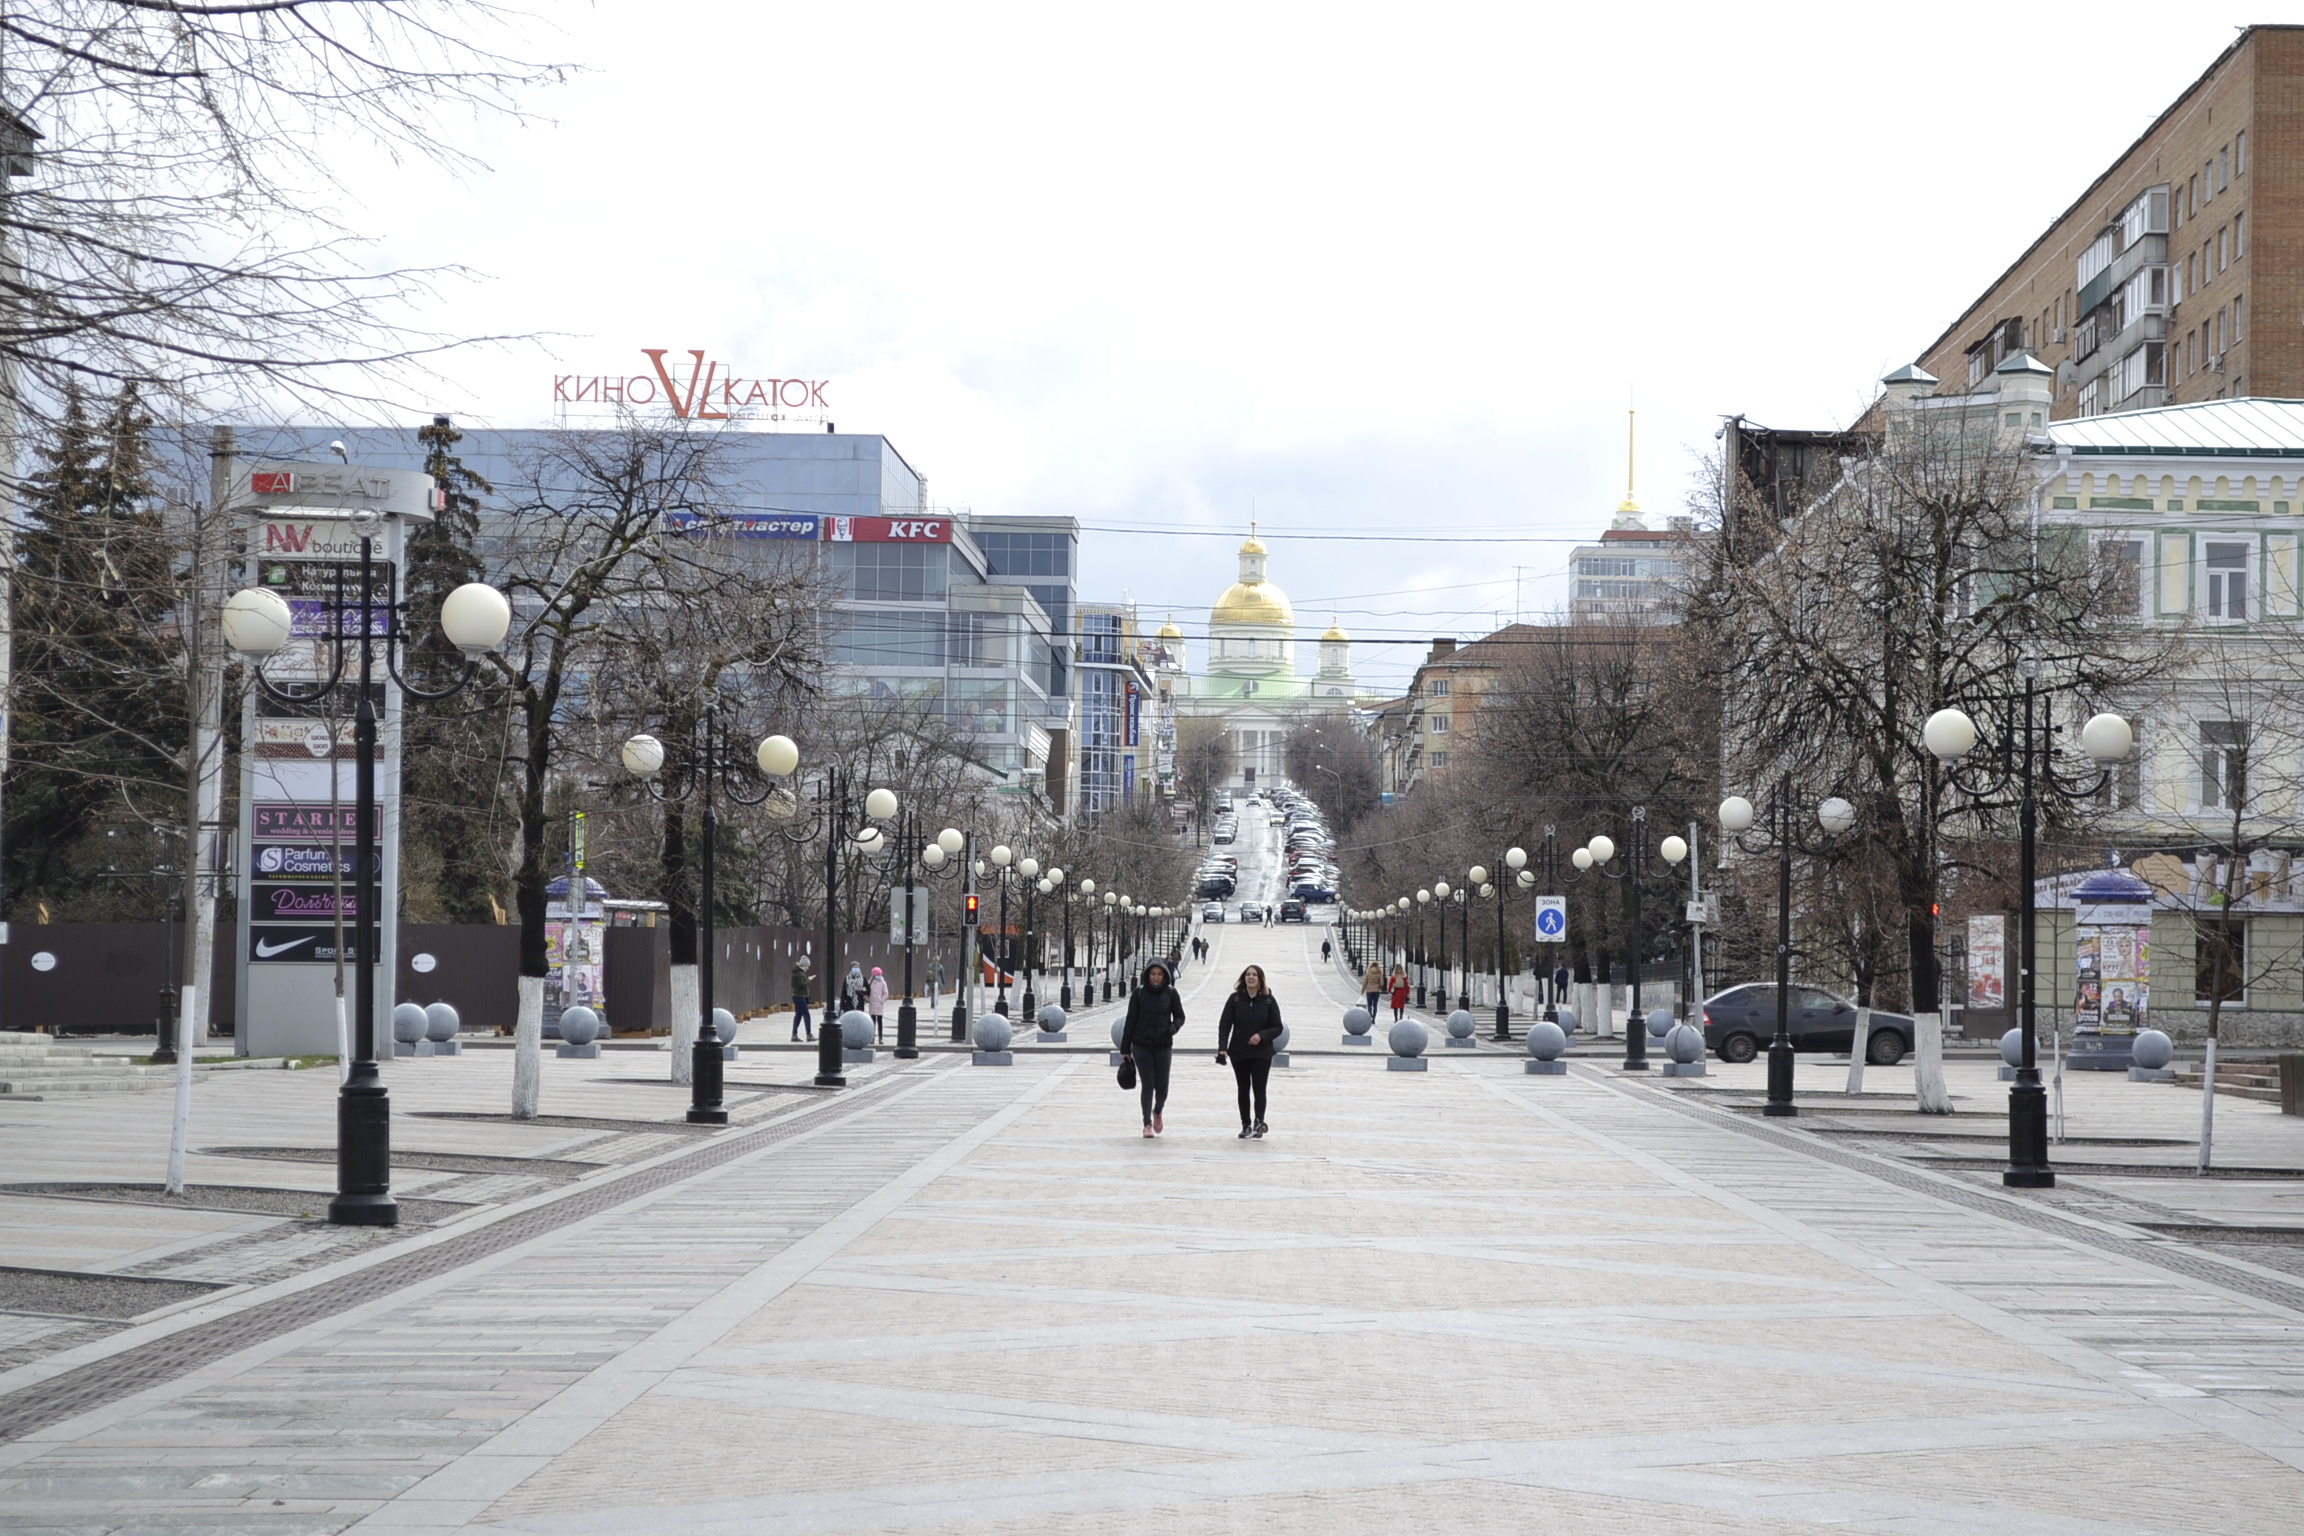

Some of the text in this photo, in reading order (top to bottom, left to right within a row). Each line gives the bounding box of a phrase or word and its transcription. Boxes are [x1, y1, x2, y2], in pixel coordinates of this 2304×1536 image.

[555, 374, 656, 404] КИНО
[723, 377, 830, 408] КАТОК
[269, 472, 391, 499] АРБАТ
[888, 521, 941, 538] KFC
